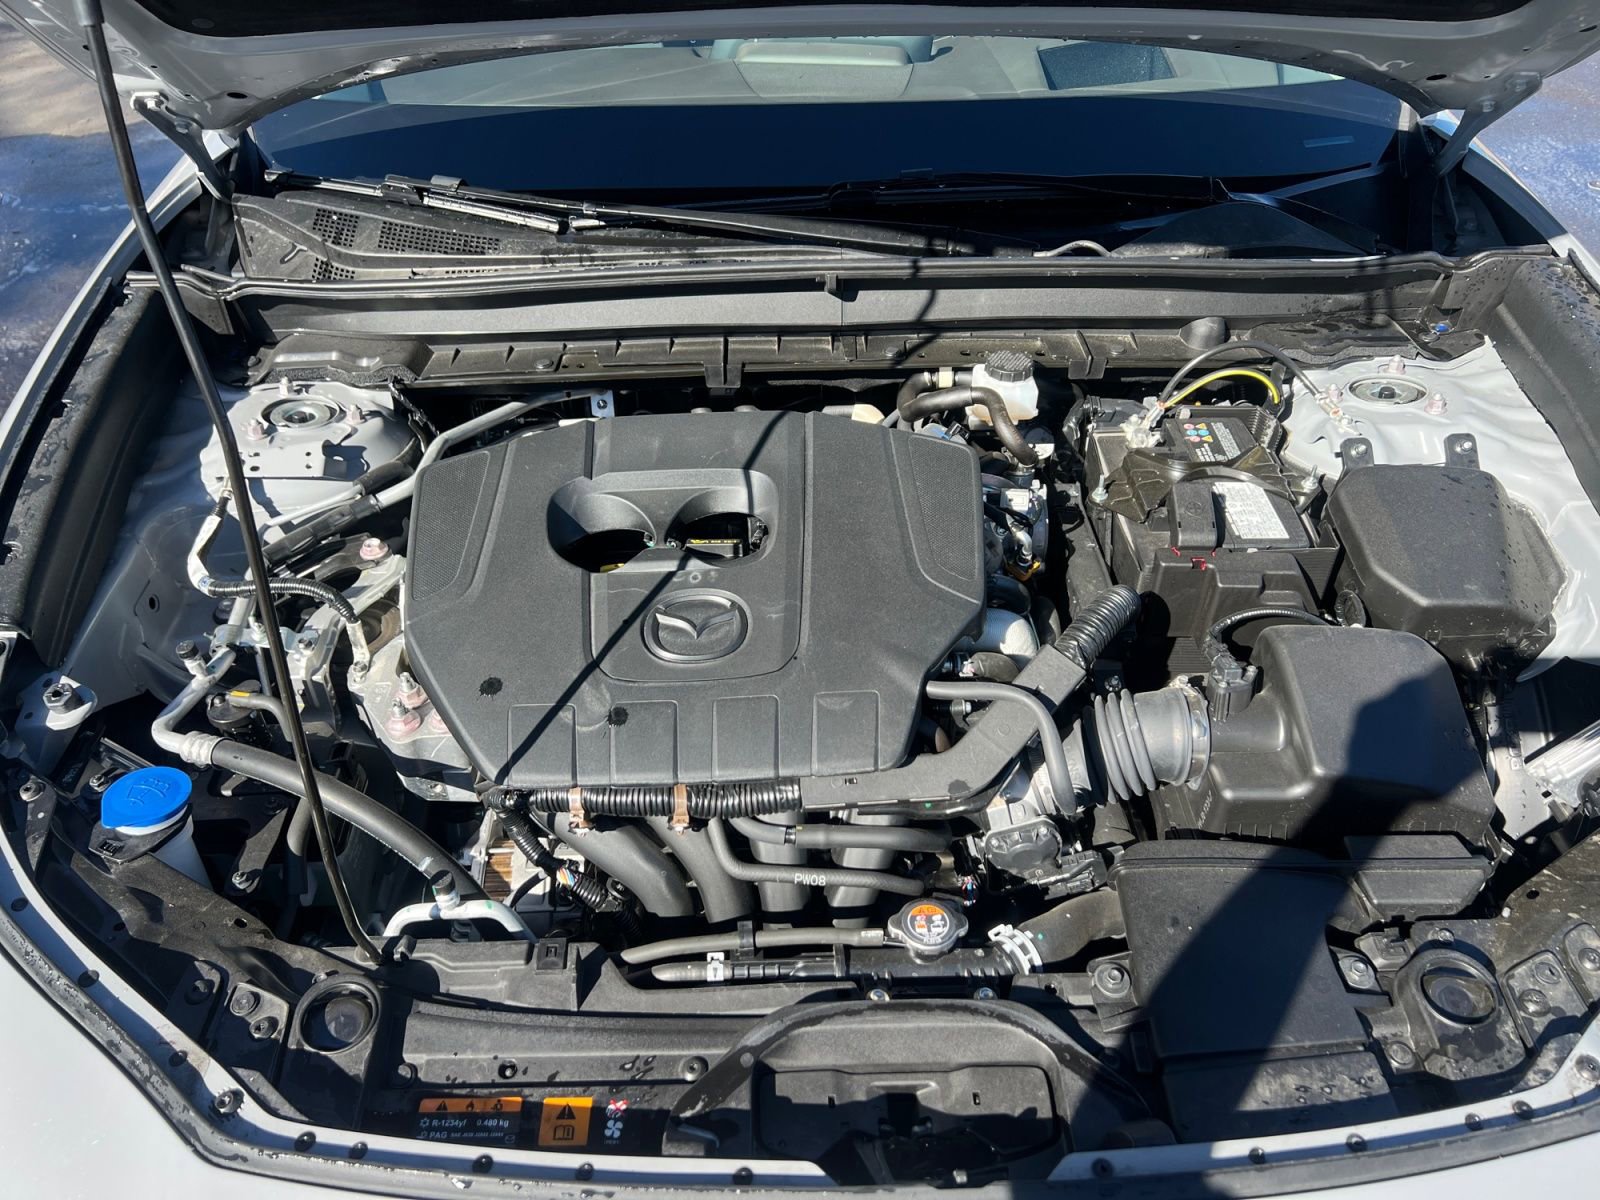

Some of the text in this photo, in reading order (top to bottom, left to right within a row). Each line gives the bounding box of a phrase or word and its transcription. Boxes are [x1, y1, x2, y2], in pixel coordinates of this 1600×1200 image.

[794, 872, 826, 886] PW08
[431, 1118, 467, 1128] R-1234yf
[498, 1118, 509, 1128] kg
[429, 1131, 448, 1139] PAG
